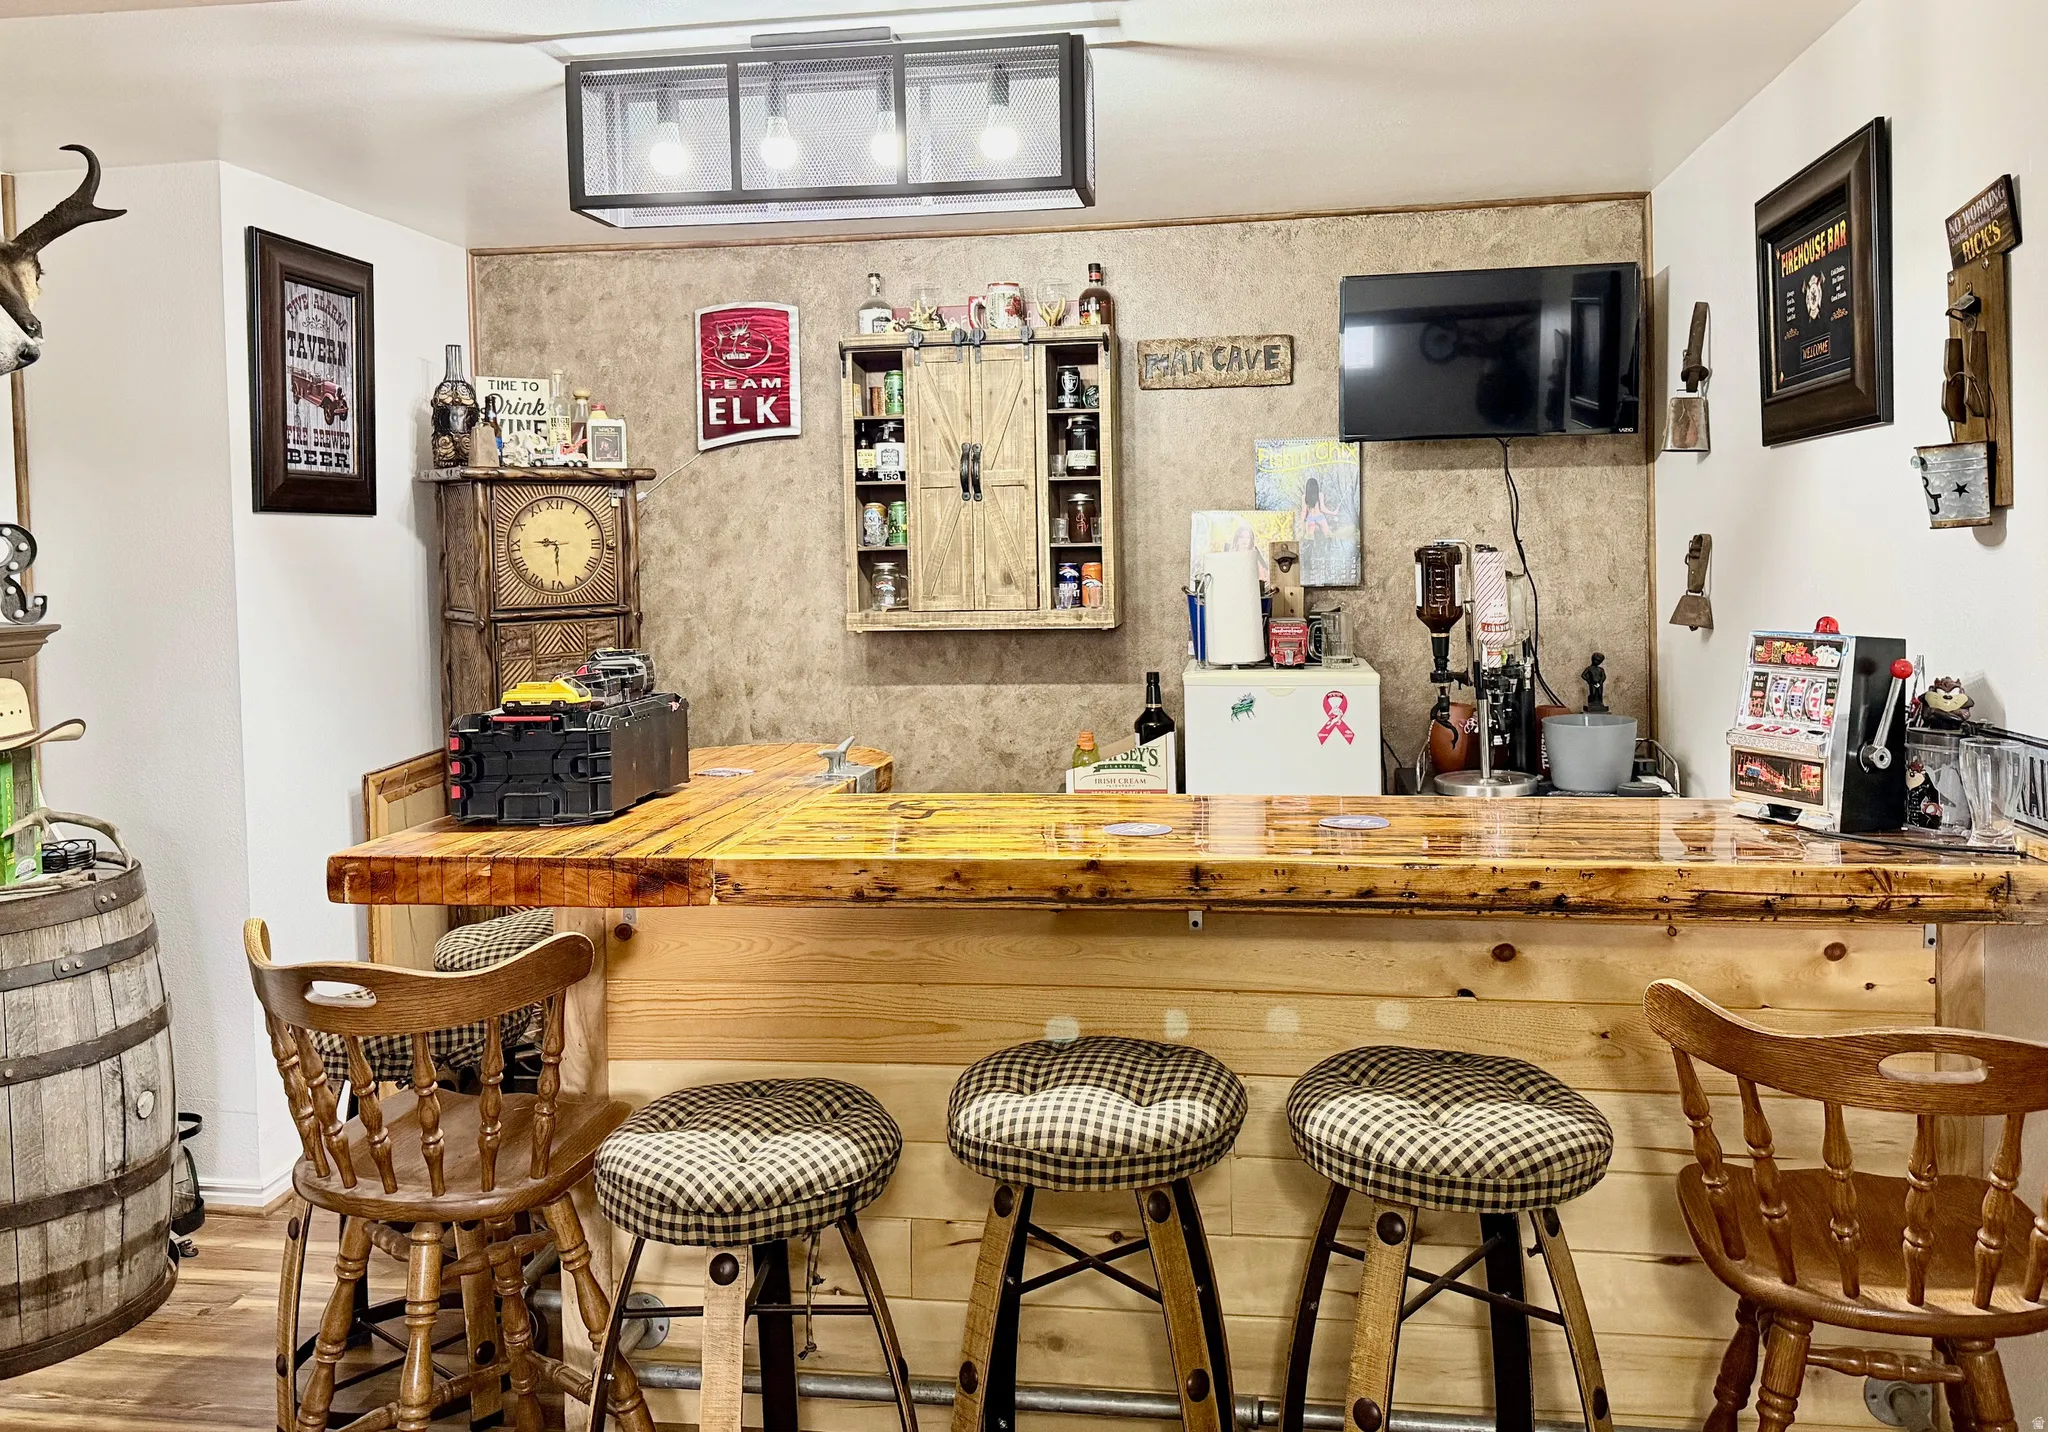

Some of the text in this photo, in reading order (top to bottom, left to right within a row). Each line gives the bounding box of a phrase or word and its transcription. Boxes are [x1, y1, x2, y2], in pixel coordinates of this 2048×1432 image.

[1948, 184, 2005, 237] NO WORKING
[1781, 219, 1847, 278] FIREHOUSE BAR
[1962, 220, 2001, 263] RICK'S
[286, 294, 347, 331] FIVE ALARM
[287, 330, 346, 366] TAVERN
[1802, 340, 1829, 360] WELCOME
[1145, 344, 1281, 380] MAN CAVE
[488, 380, 539, 392] TIME TO
[706, 378, 782, 390] TEAM
[481, 393, 546, 416] Drink
[708, 396, 780, 425] ELK
[286, 426, 350, 450] FIRE BREWED
[287, 448, 350, 468] BEER
[546, 500, 564, 510] XII
[1811, 698, 1819, 708] 7
